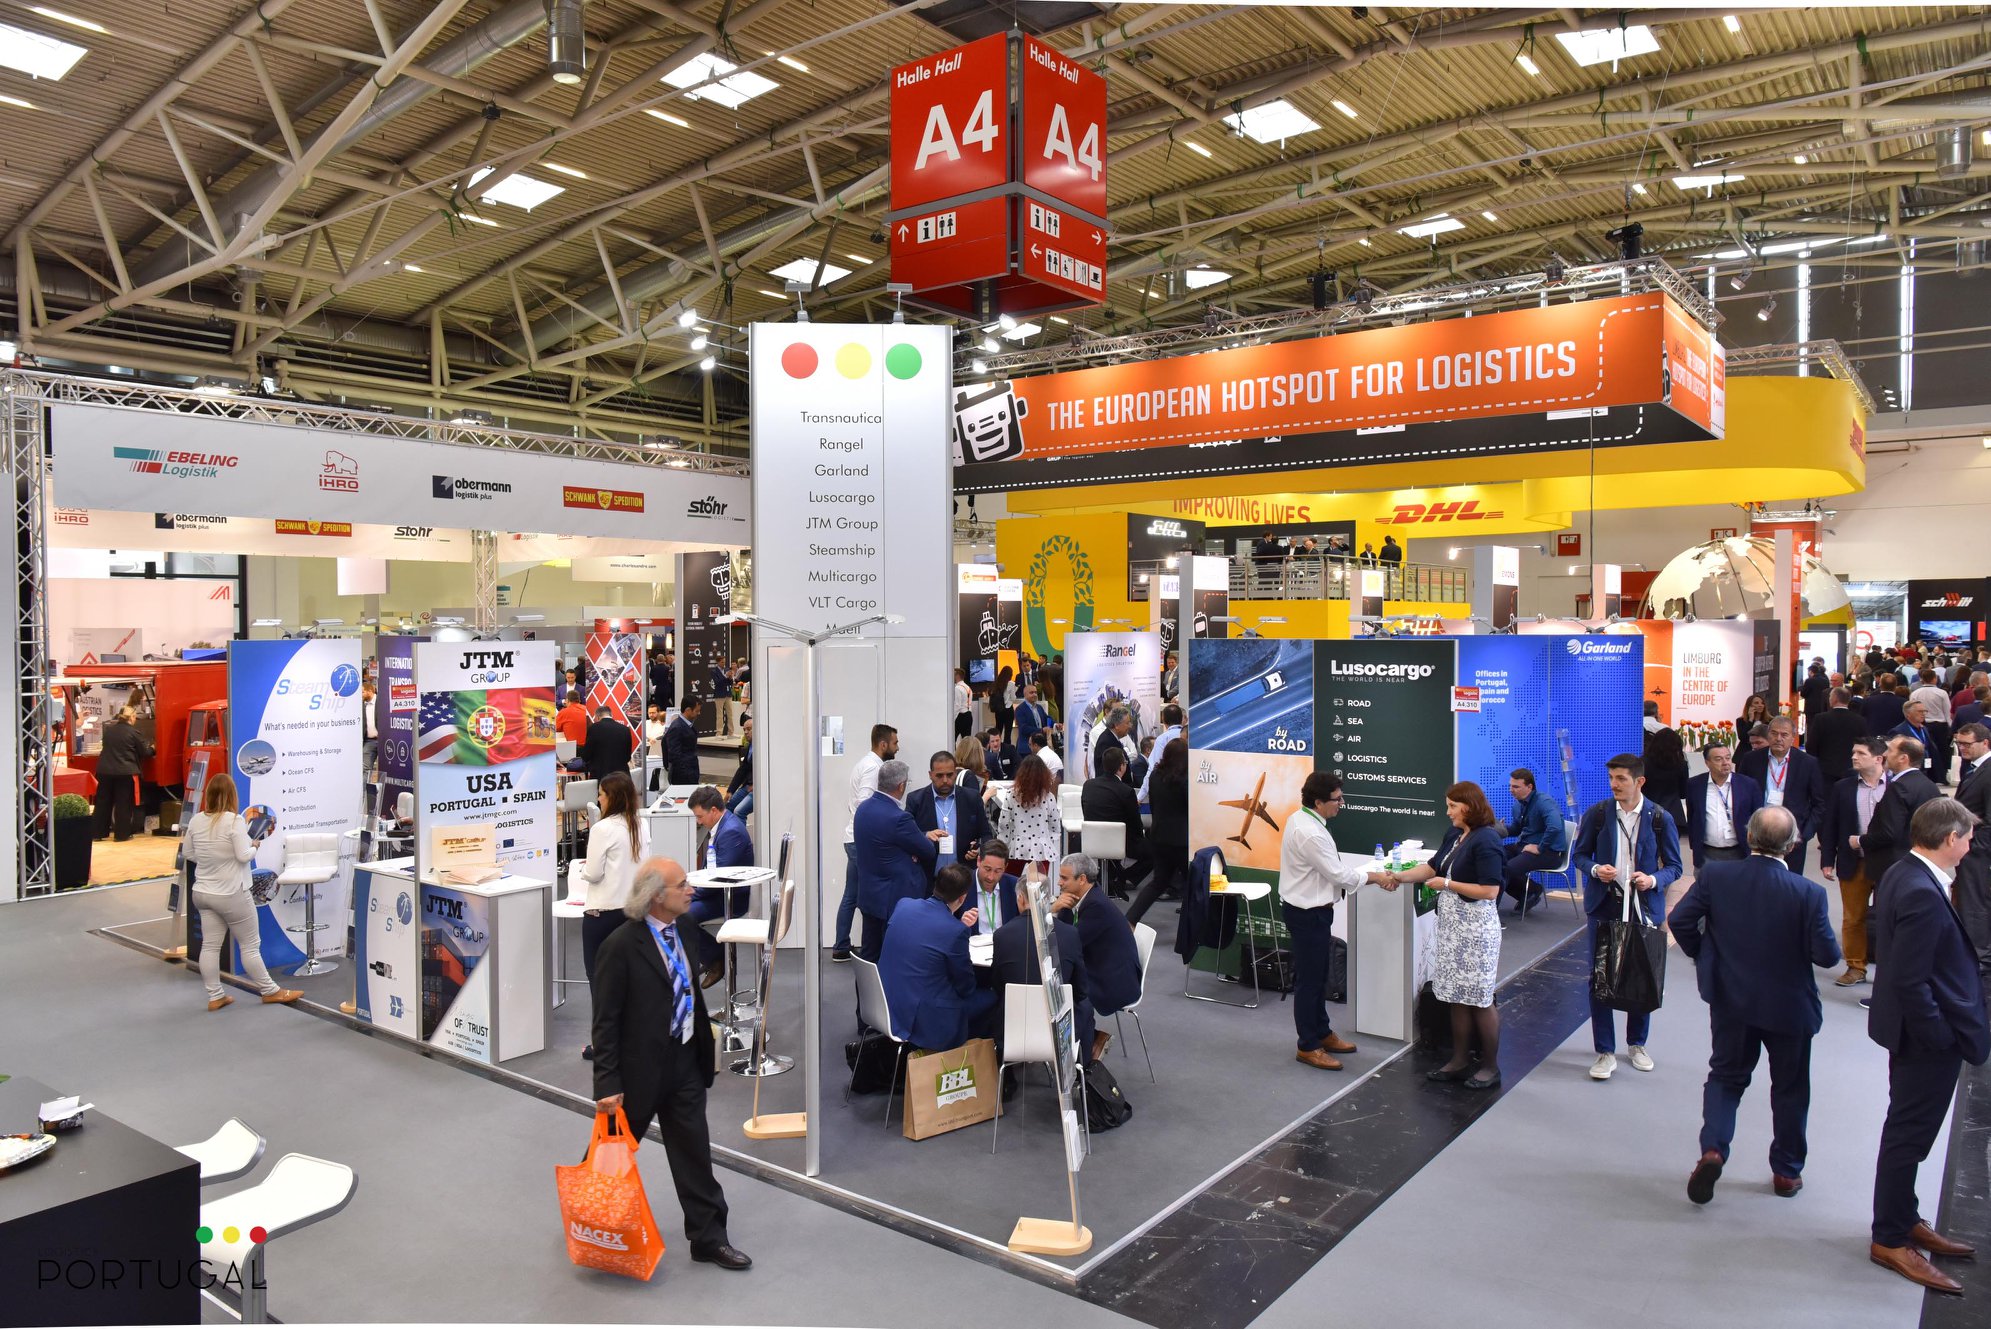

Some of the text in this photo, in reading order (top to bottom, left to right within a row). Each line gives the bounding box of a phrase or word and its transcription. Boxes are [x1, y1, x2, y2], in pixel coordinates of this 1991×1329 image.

[897, 52, 963, 88] Halle Hall
[1030, 43, 1079, 84] Halle Hall
[914, 89, 999, 171] A4
[1043, 103, 1102, 182] A4
[1048, 341, 1576, 431] THE EUROPEAN HOTSPOT FOR LOGISTICS
[800, 411, 882, 425] Transnautica
[820, 438, 864, 453] Rangel
[167, 451, 239, 468] EBELING
[162, 466, 218, 479] Logistik
[815, 465, 869, 477] Garland
[455, 478, 512, 493] obermann
[456, 491, 493, 501] logistik plus
[565, 491, 642, 507] SCHWANK SPEDITION
[809, 491, 875, 507] Lusocargo
[1174, 496, 1311, 524] IMPROVING LIVES
[1392, 500, 1488, 524] DHL
[176, 514, 227, 524] obermann
[806, 518, 878, 533] JTM Group
[276, 520, 351, 533] SCHWANK SPEDITION
[809, 544, 876, 560] Steamship
[808, 570, 877, 586] Multicargo
[808, 597, 877, 612] VLT Cargo
[1582, 641, 1633, 654] Garland
[385, 657, 412, 670] INTERNATIO
[460, 651, 514, 670] JTM
[1684, 652, 1722, 664] LIMBURG
[1476, 670, 1508, 678] Offices in
[1683, 666, 1710, 678] IN THE
[1476, 679, 1508, 687] Portugal,
[1682, 680, 1729, 692] CENTRE OF
[1480, 687, 1509, 696] pain and
[1347, 700, 1371, 708] ROAD
[1682, 694, 1716, 705] EUROPE
[265, 722, 286, 732] What's
[287, 720, 309, 730] needed
[310, 720, 316, 728] in
[317, 721, 330, 731] your
[331, 718, 356, 728] business
[1347, 718, 1363, 726] SEA
[1276, 726, 1288, 740] by
[1347, 735, 1362, 743] AIR
[1267, 738, 1307, 751] ROAD
[288, 749, 319, 757] Warehousing
[1347, 754, 1388, 764] LOGISTICS
[1200, 760, 1211, 771] by
[466, 772, 514, 793] USA
[1196, 771, 1218, 785] AIR
[1347, 772, 1427, 785] CUSTOMS SERVICES
[288, 804, 316, 813] Distribution
[430, 791, 547, 813] PORTUGAL SPAIN
[464, 809, 518, 820] www.jtmgc.com
[1347, 804, 1379, 813] Lusocargo
[1392, 807, 1411, 815] world
[288, 818, 348, 831] Multimodal Transportation
[495, 818, 534, 829] OGISTICS
[427, 895, 463, 920] JTM
[454, 1018, 489, 1038] OF TRUST
[939, 1068, 973, 1094] BBL
[571, 1221, 624, 1245] NACEX
